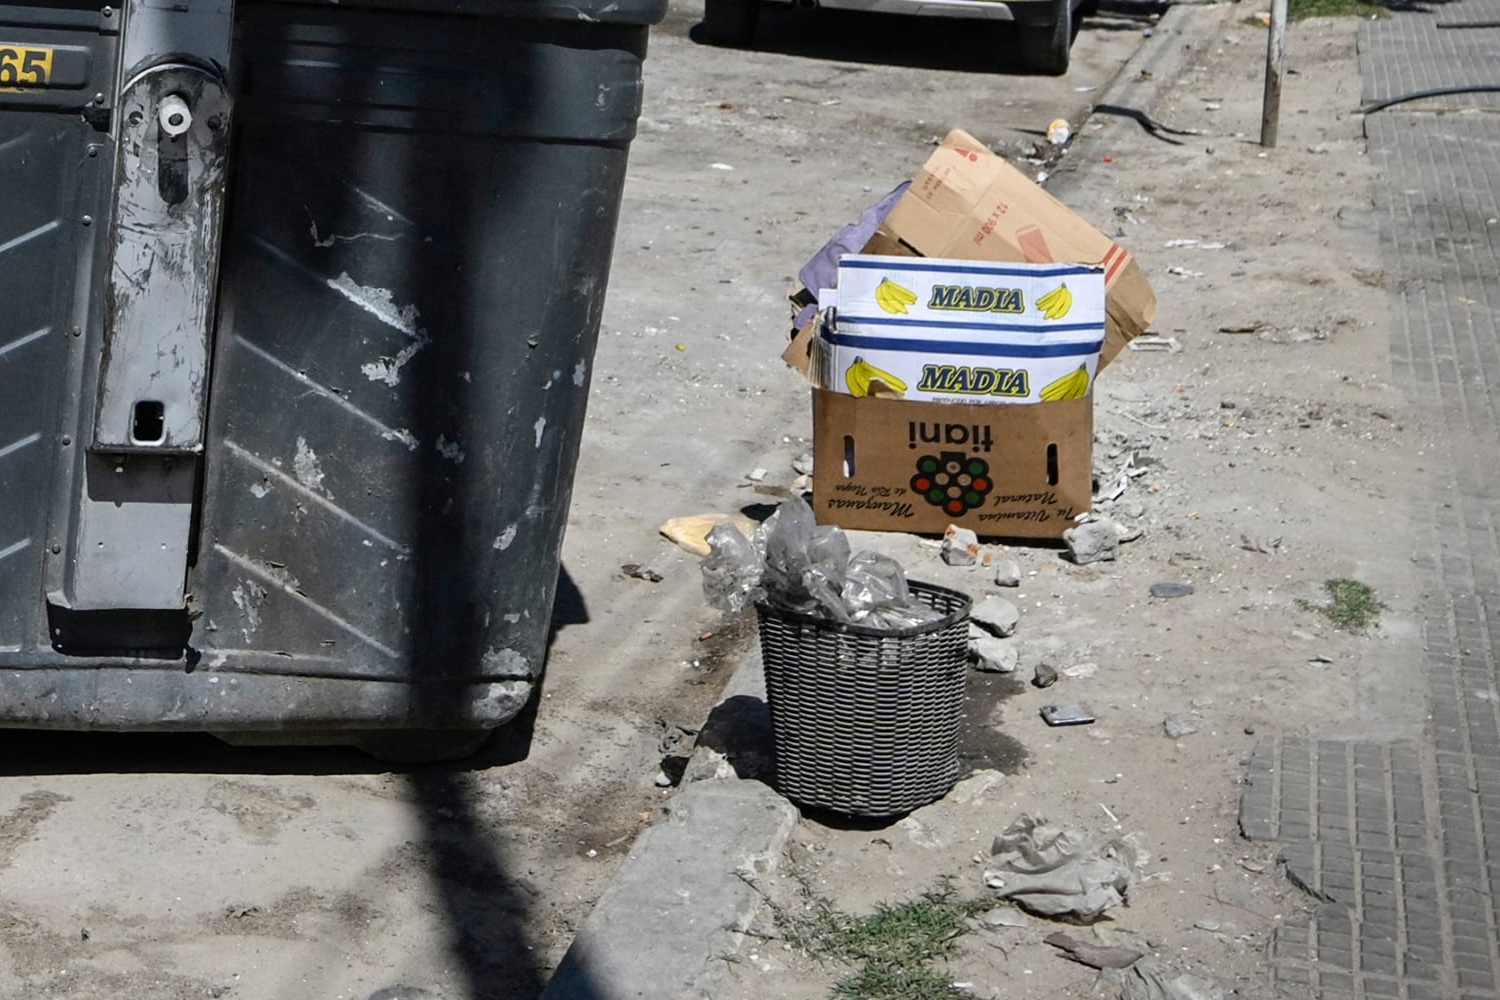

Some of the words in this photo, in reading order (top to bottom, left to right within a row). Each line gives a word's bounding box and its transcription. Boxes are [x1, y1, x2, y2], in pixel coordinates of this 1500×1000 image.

[927, 284, 1026, 314] MADIA
[917, 363, 1031, 398] MADIA
[908, 421, 994, 453] tiani
[835, 482, 868, 496] Negro
[894, 487, 908, 498] de
[827, 496, 915, 518] Manzanas
[993, 491, 1058, 508] Natural
[978, 508, 1051, 523] Vitamina
